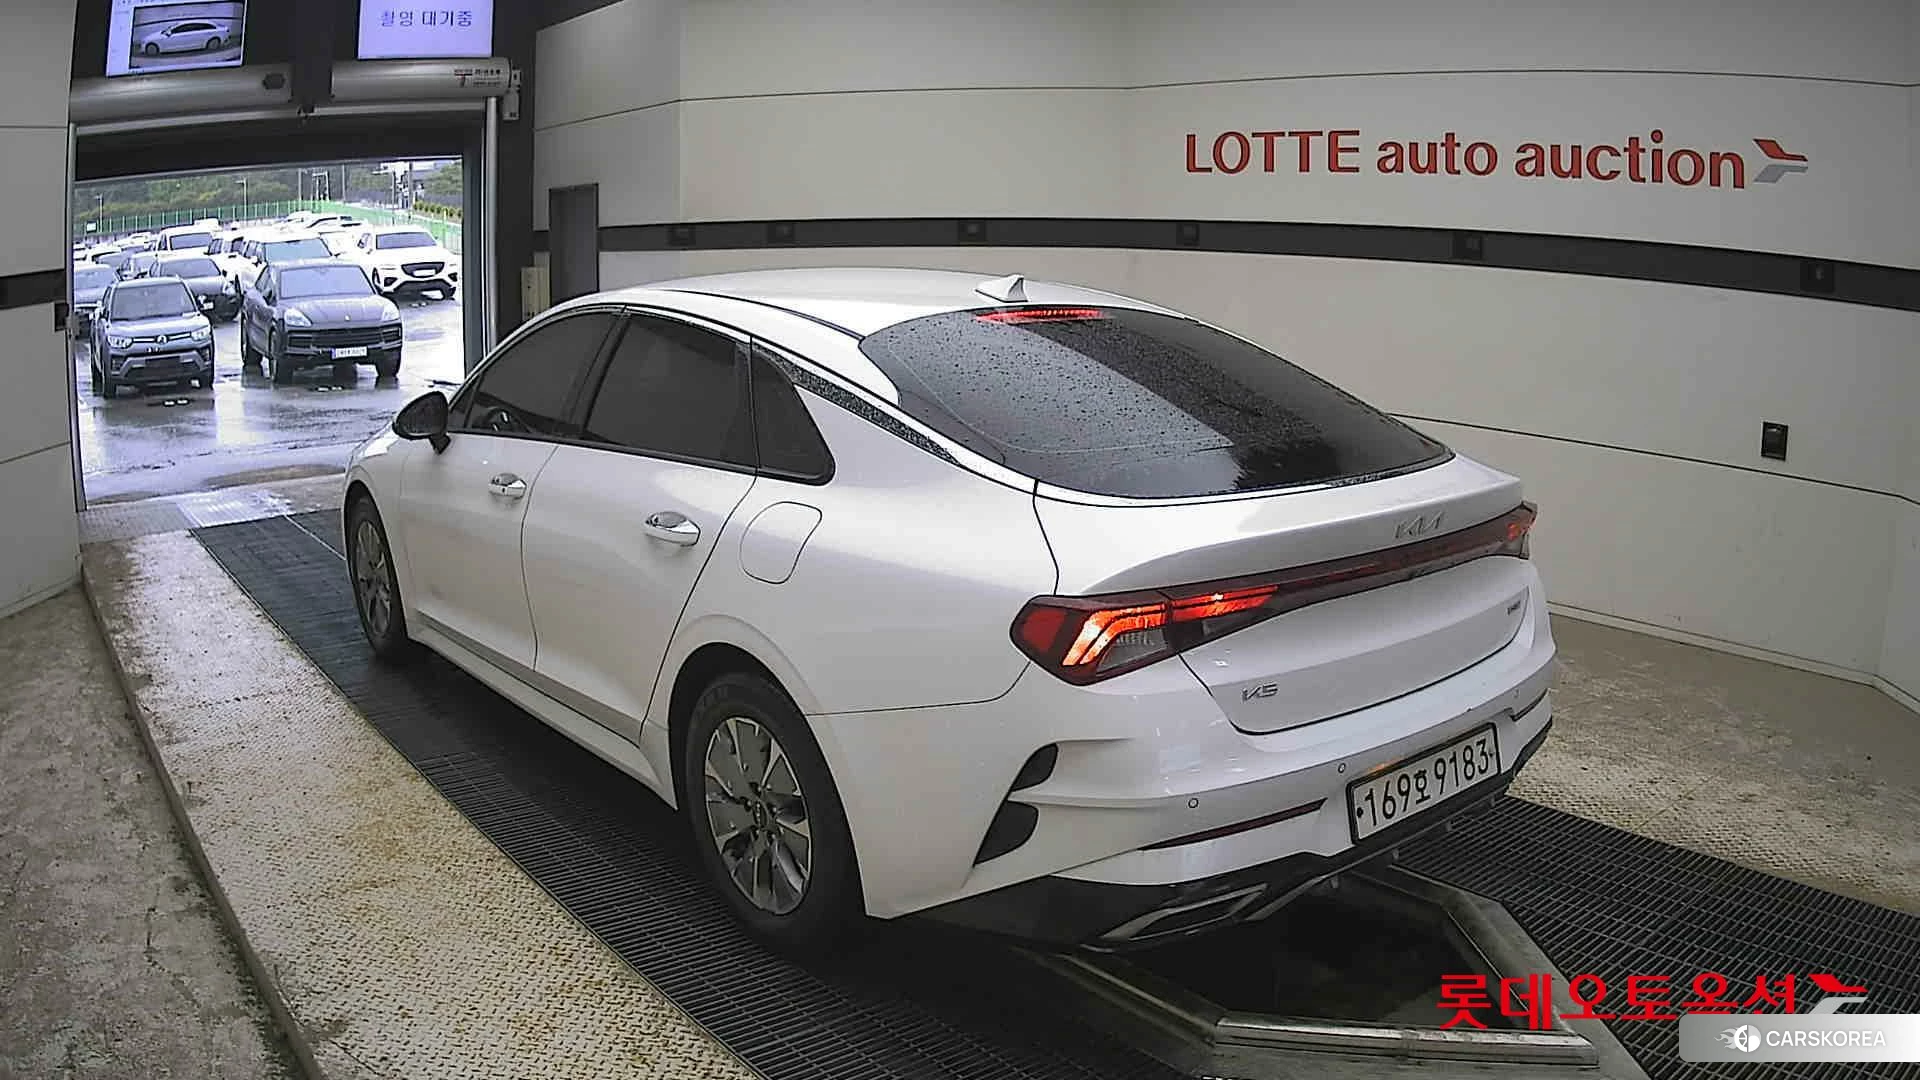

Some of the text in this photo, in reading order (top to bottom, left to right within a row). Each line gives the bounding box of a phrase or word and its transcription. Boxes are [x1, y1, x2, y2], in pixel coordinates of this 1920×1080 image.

[422, 10, 472, 27] 대기중
[1185, 129, 1746, 189] LOTTE auto auction
